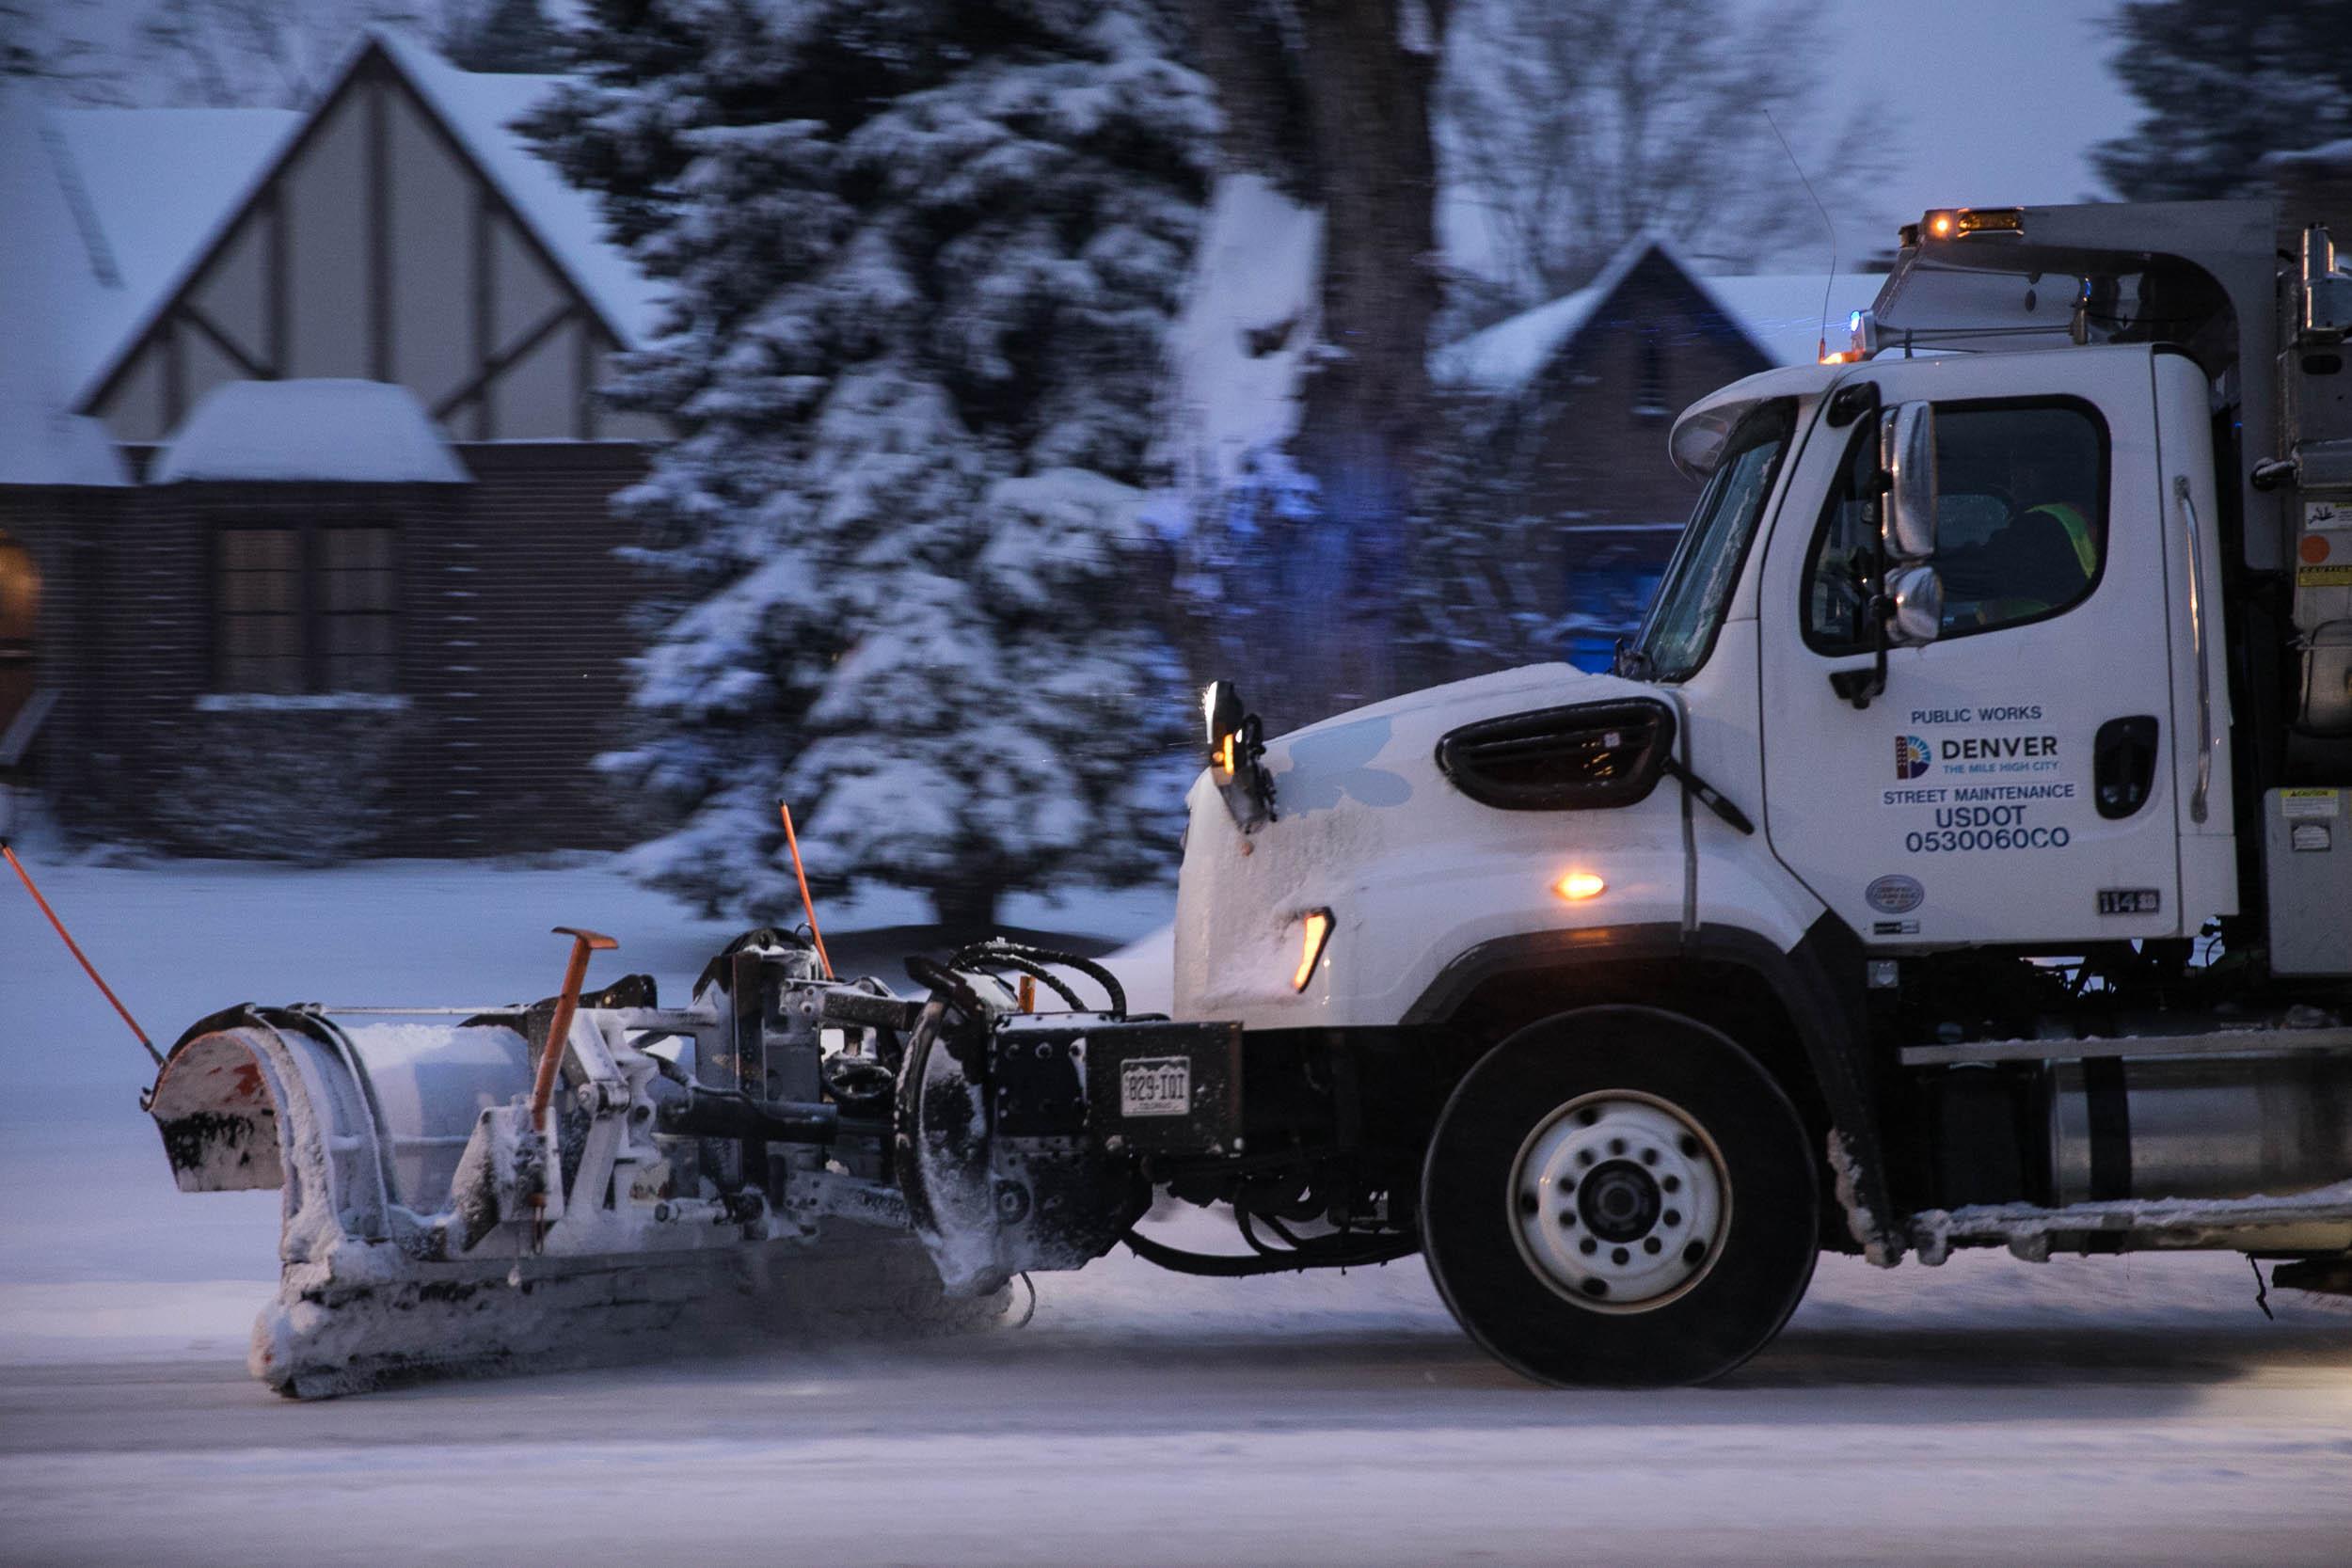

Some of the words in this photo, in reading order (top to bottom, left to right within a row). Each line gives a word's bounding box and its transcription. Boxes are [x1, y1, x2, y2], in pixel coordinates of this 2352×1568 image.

[1911, 708, 1972, 724] PUBLIC
[1978, 705, 2042, 721] WORKS
[1942, 736, 2058, 760] DENVER
[1943, 764, 1964, 774] THE
[1968, 763, 1995, 773] MILE
[1999, 761, 2029, 772] HIGH
[2032, 760, 2059, 771] CITY
[1883, 788, 1947, 805] STREET
[1954, 784, 2074, 801] MAINTENANCE
[1935, 805, 2026, 829] USDOT
[1905, 827, 2070, 853] 0530060CO
